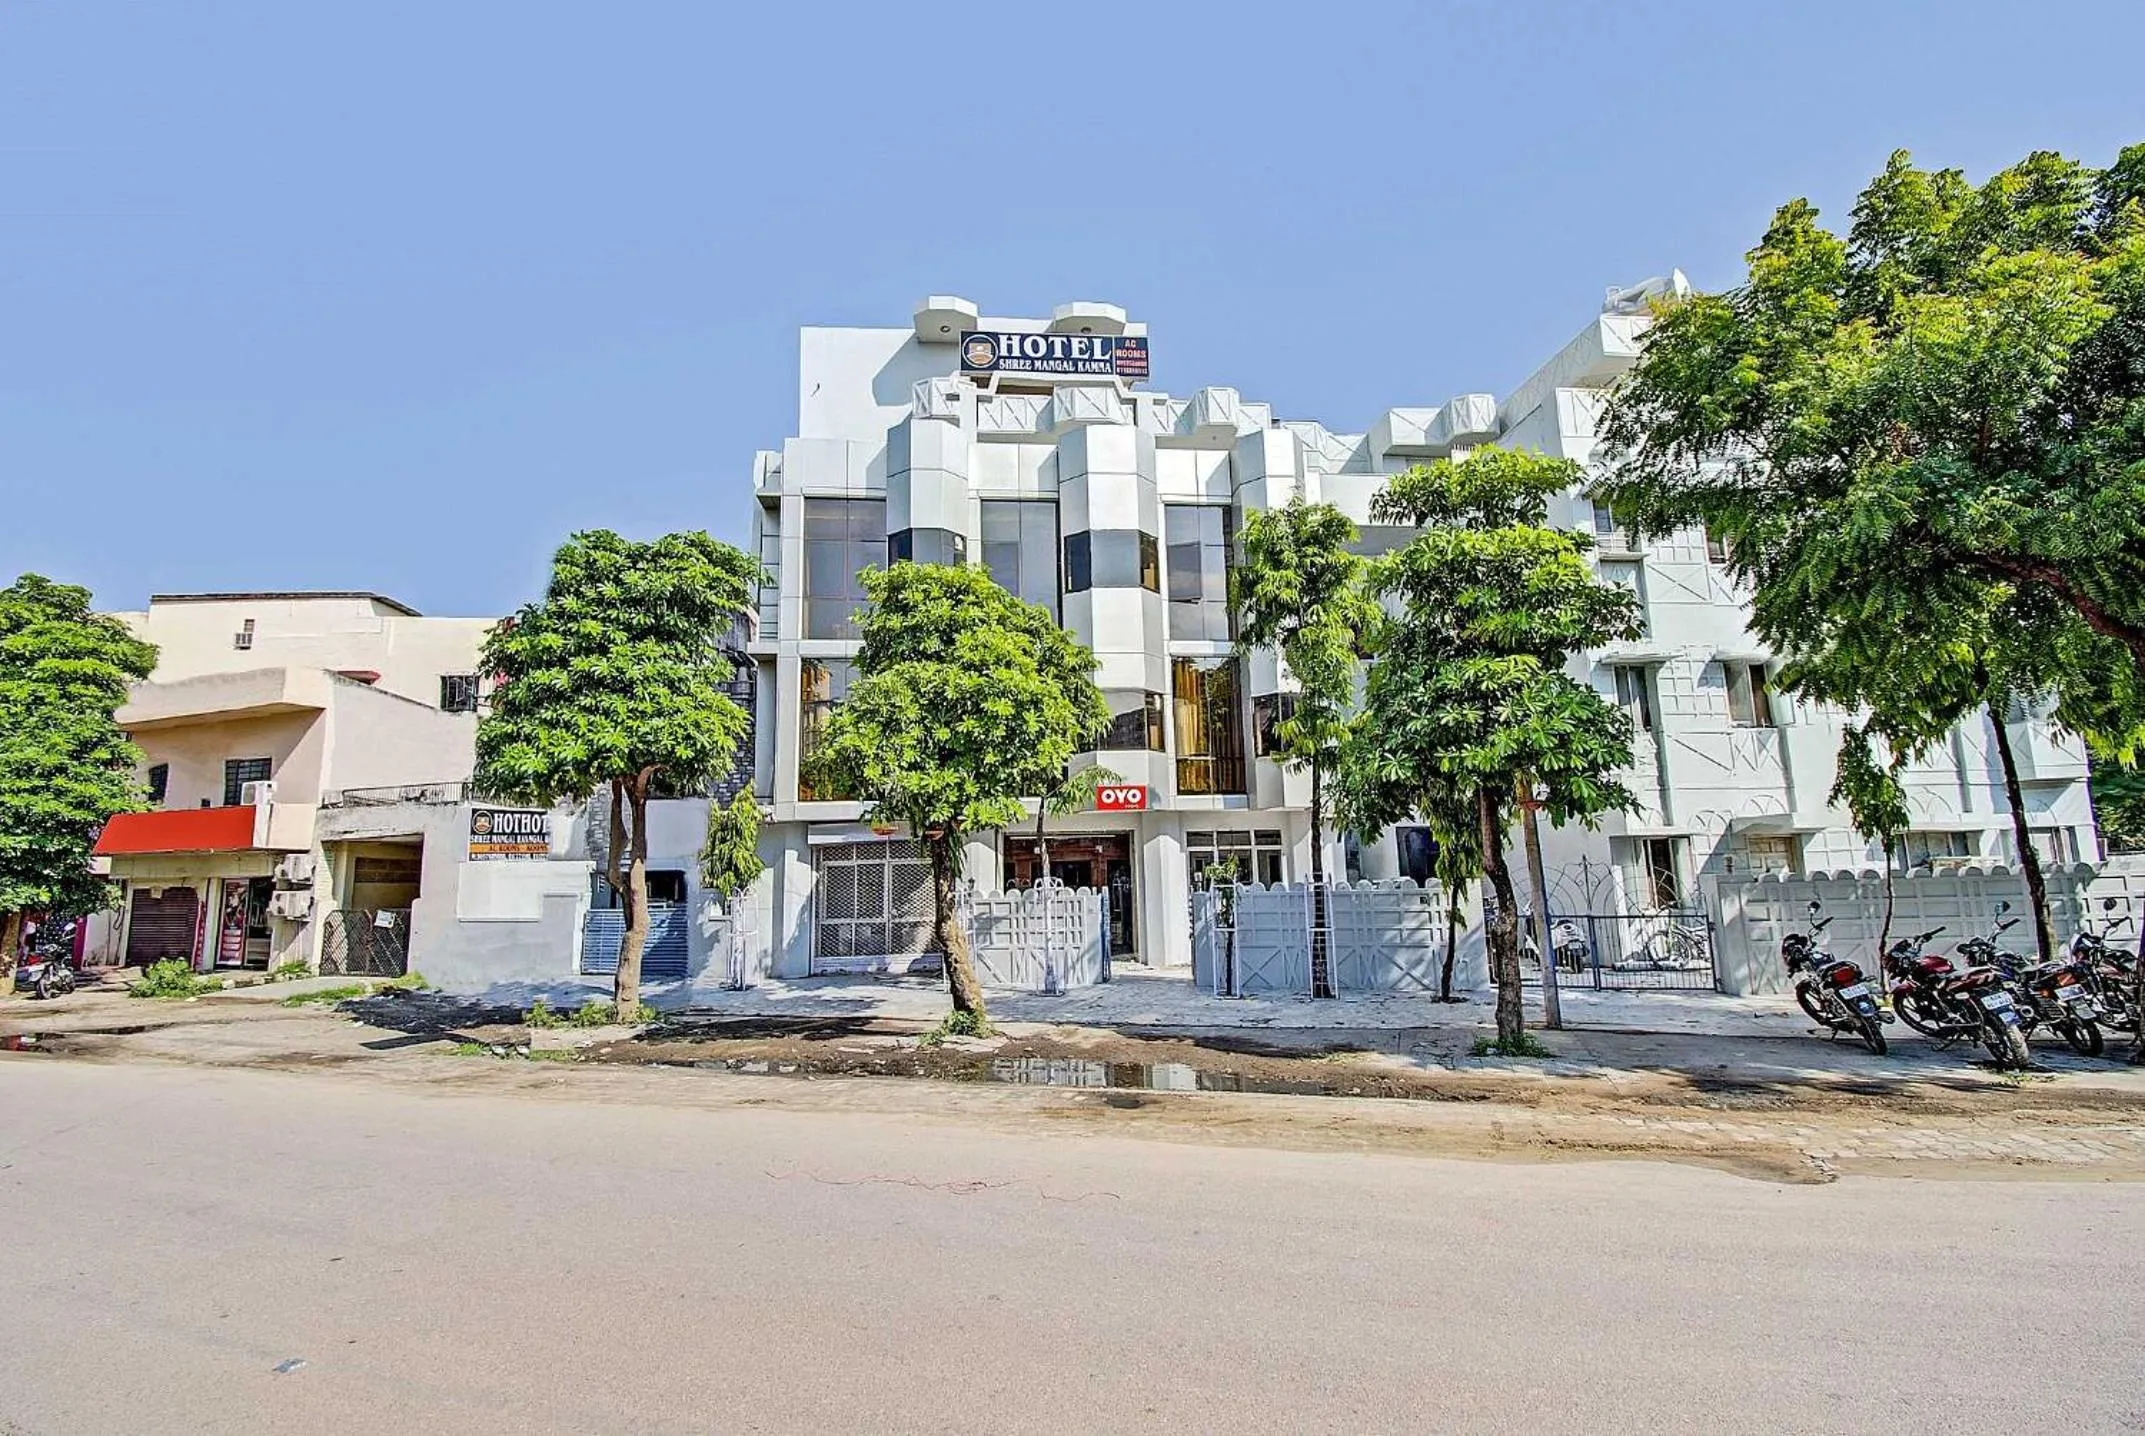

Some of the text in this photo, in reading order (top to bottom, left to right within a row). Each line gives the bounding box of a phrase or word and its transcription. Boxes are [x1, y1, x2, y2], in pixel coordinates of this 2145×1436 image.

[998, 334, 1112, 360] HOTEL
[1116, 349, 1146, 358] ROOMS
[999, 358, 1032, 370] SHREE
[1034, 359, 1075, 372] MANGAL
[1101, 788, 1142, 804] OYO
